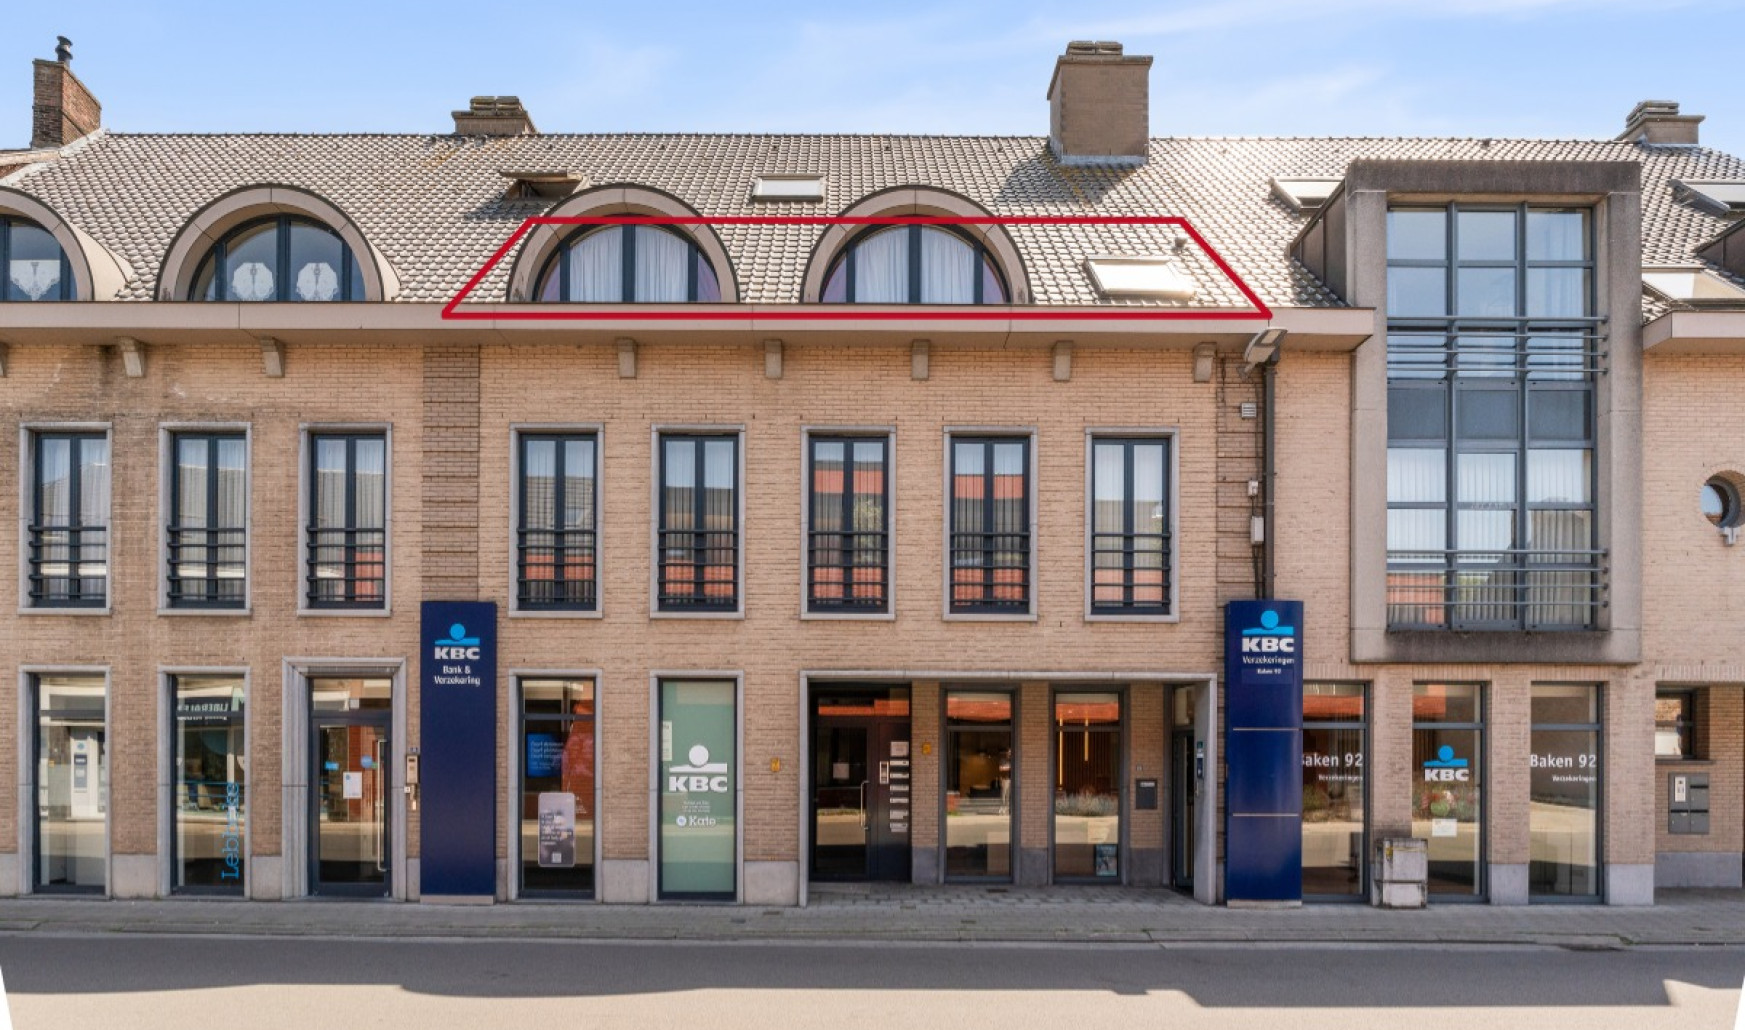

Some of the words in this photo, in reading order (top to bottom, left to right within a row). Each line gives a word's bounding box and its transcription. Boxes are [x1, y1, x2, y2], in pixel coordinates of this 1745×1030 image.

[1242, 637, 1294, 652] KBC
[434, 647, 480, 660] KBC
[1242, 655, 1294, 665] Verzekeringen
[442, 665, 462, 674] Bank
[464, 665, 471, 674] &
[434, 675, 480, 687] Verzekering
[1344, 752, 1363, 767] 92
[1530, 753, 1573, 767] Baken
[1579, 754, 1596, 767] 92
[1424, 768, 1469, 781] KBC
[668, 776, 728, 793] KBC
[688, 815, 717, 827] Kate
